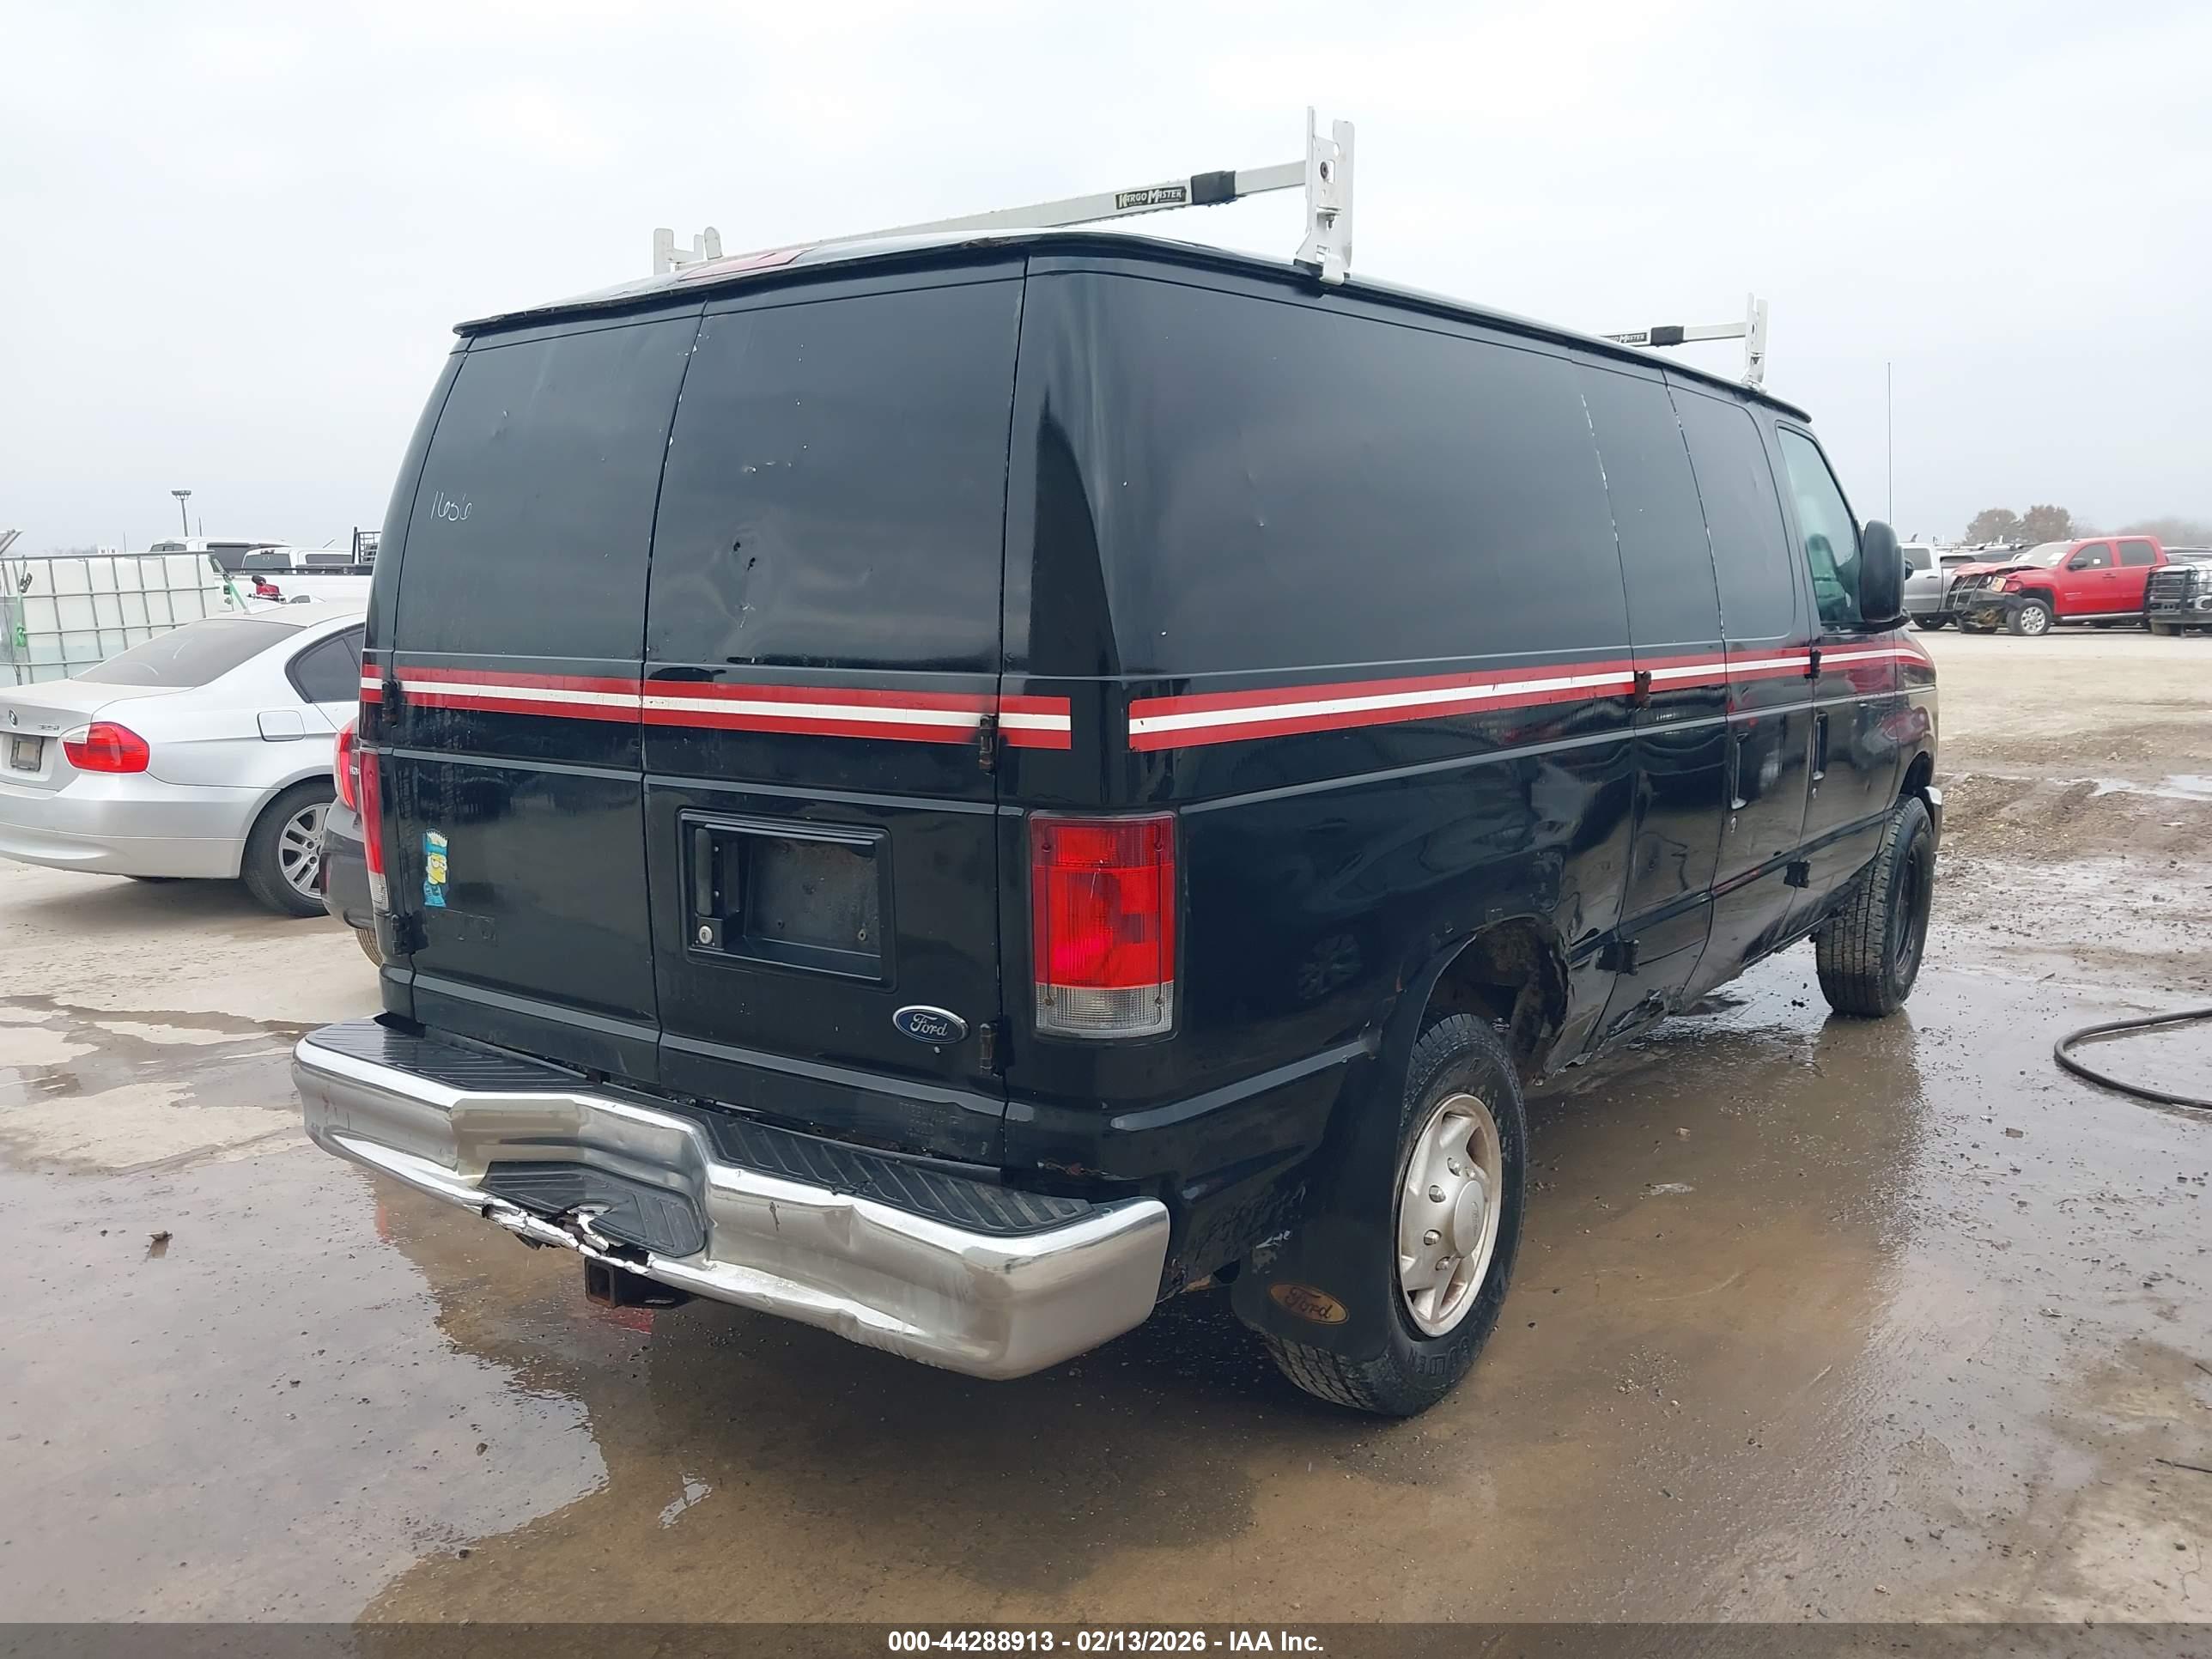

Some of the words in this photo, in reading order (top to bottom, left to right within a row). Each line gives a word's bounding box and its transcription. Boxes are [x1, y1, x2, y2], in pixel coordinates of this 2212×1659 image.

[1147, 189, 1182, 204] MASTER
[909, 1013, 948, 1036] Ford
[1285, 1286, 1333, 1319] Ford
